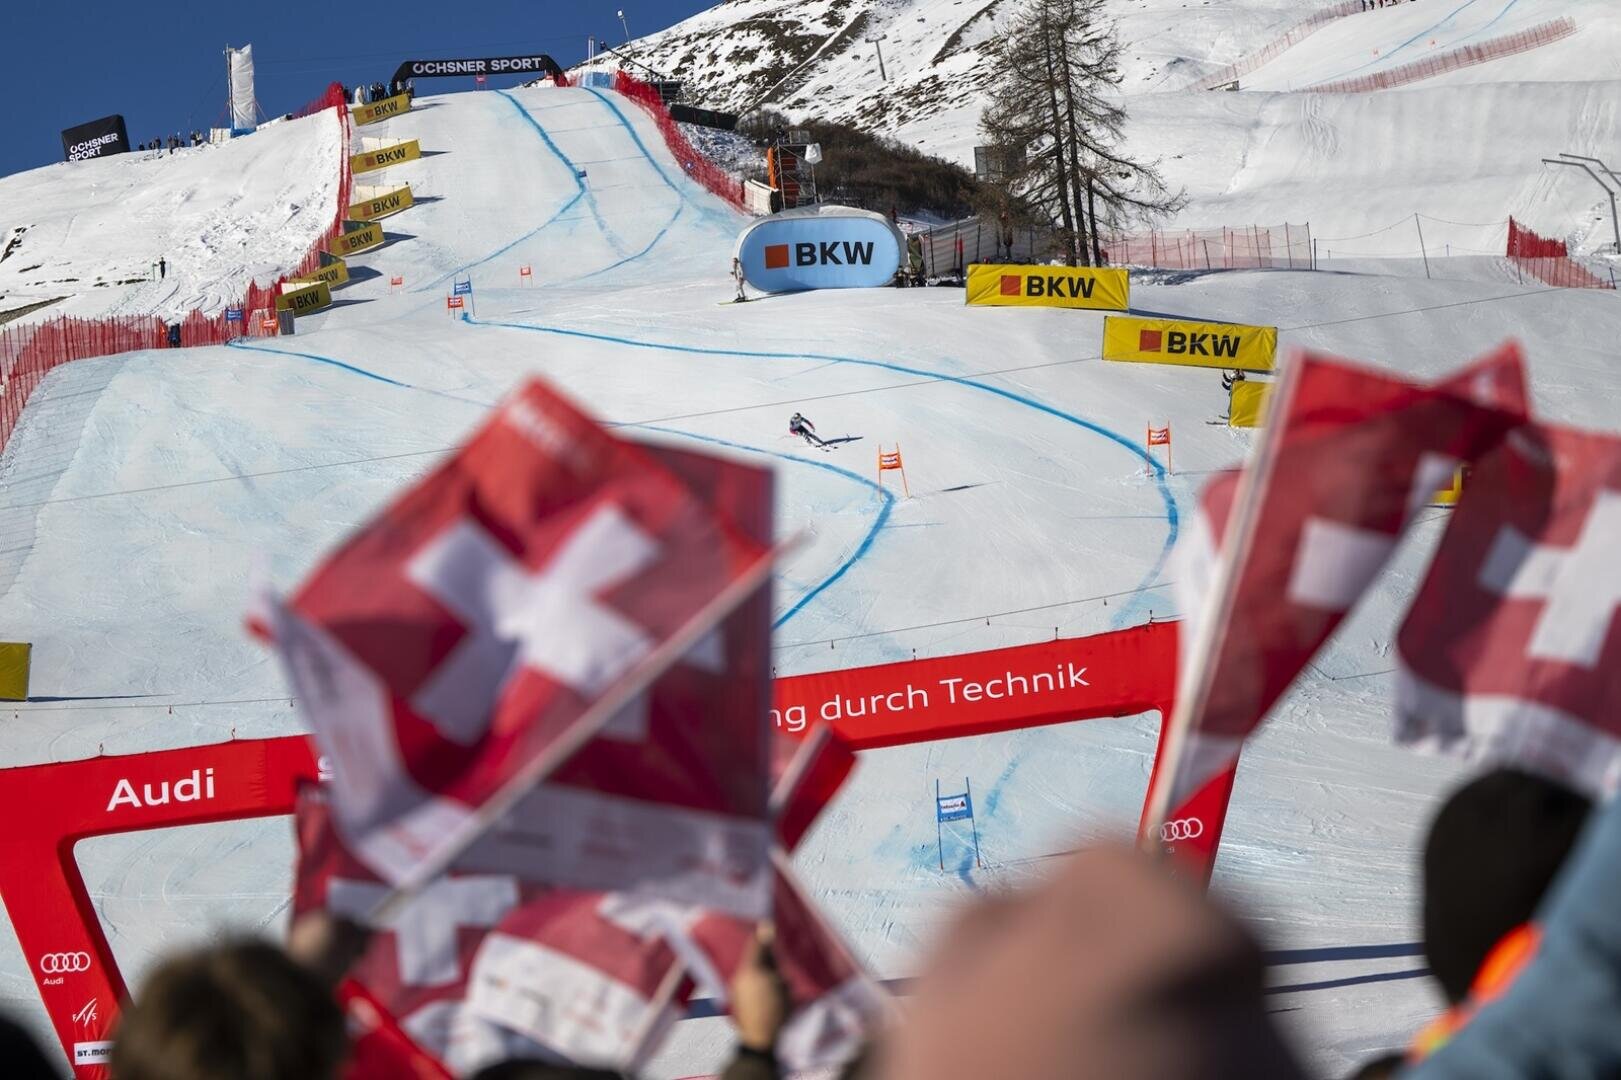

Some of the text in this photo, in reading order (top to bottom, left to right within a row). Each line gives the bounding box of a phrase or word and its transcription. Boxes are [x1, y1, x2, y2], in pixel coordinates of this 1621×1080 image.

[491, 57, 542, 71] SPORT
[374, 101, 398, 116] BKW
[70, 132, 119, 154] OCHSNER
[69, 146, 101, 162] SPORT
[376, 148, 406, 164] BKW
[372, 195, 400, 214] BKW
[349, 231, 373, 249] BKW
[794, 240, 875, 266] BKW
[1026, 275, 1096, 299] BKW
[296, 290, 319, 309] BKW
[1167, 329, 1241, 358] BKW
[820, 683, 929, 721] durch
[939, 662, 1090, 704] Technik
[106, 767, 216, 812] Audi
[43, 976, 65, 986] Audi
